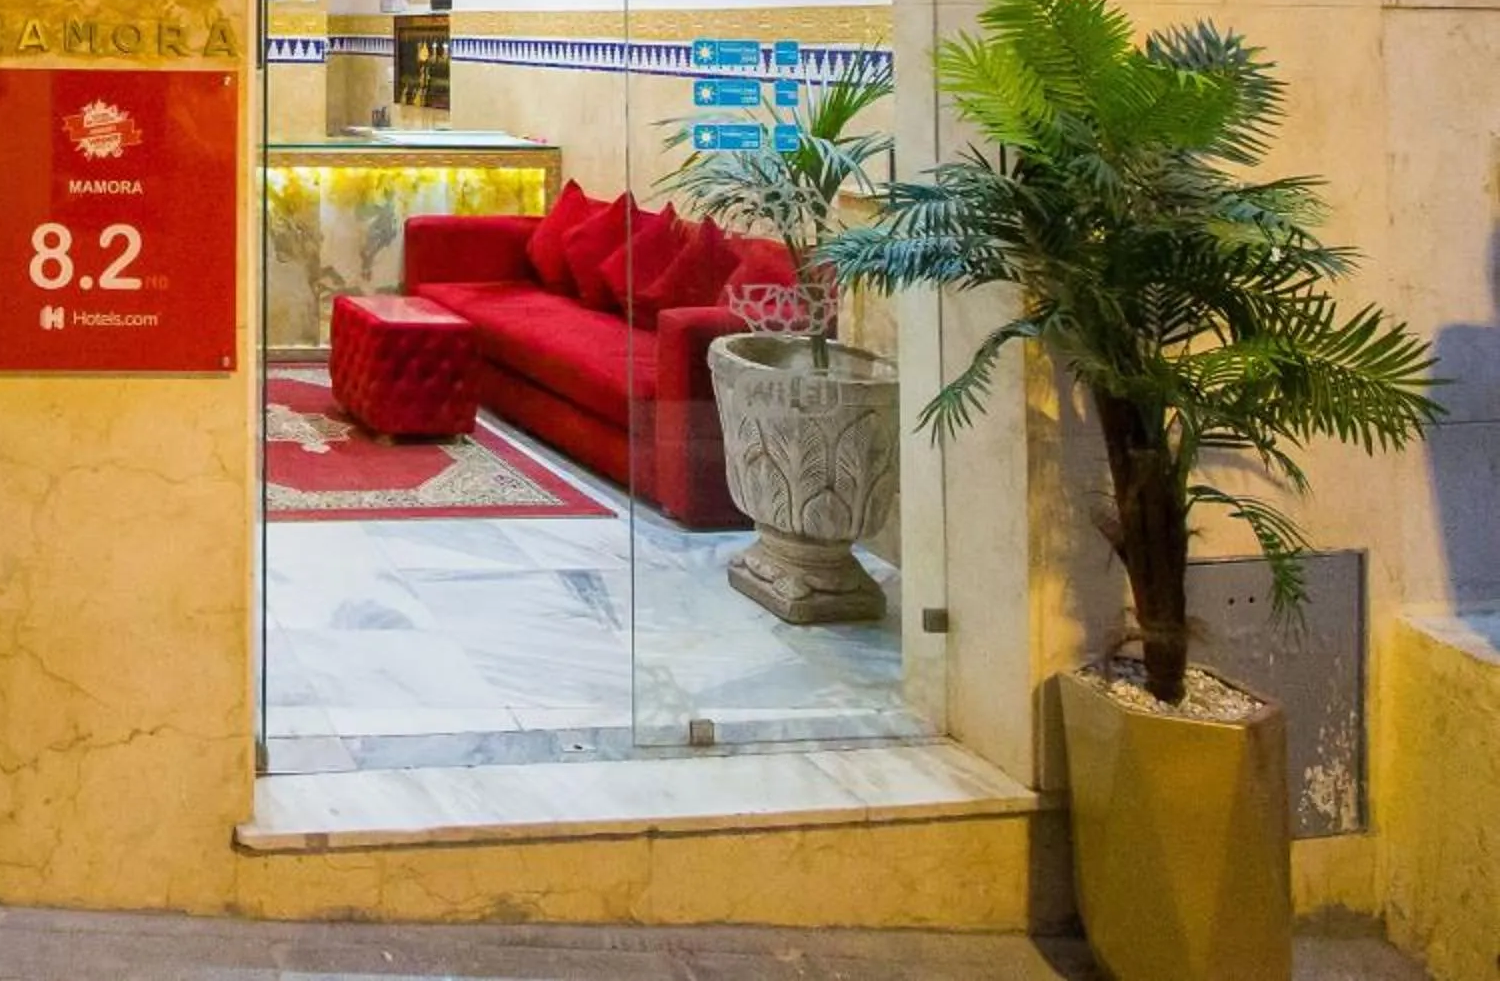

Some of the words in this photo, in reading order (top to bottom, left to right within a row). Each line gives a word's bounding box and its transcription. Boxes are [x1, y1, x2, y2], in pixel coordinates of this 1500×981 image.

[69, 179, 144, 195] MAMORA
[29, 222, 142, 290] 8.2
[73, 310, 159, 326] Hotels.com
